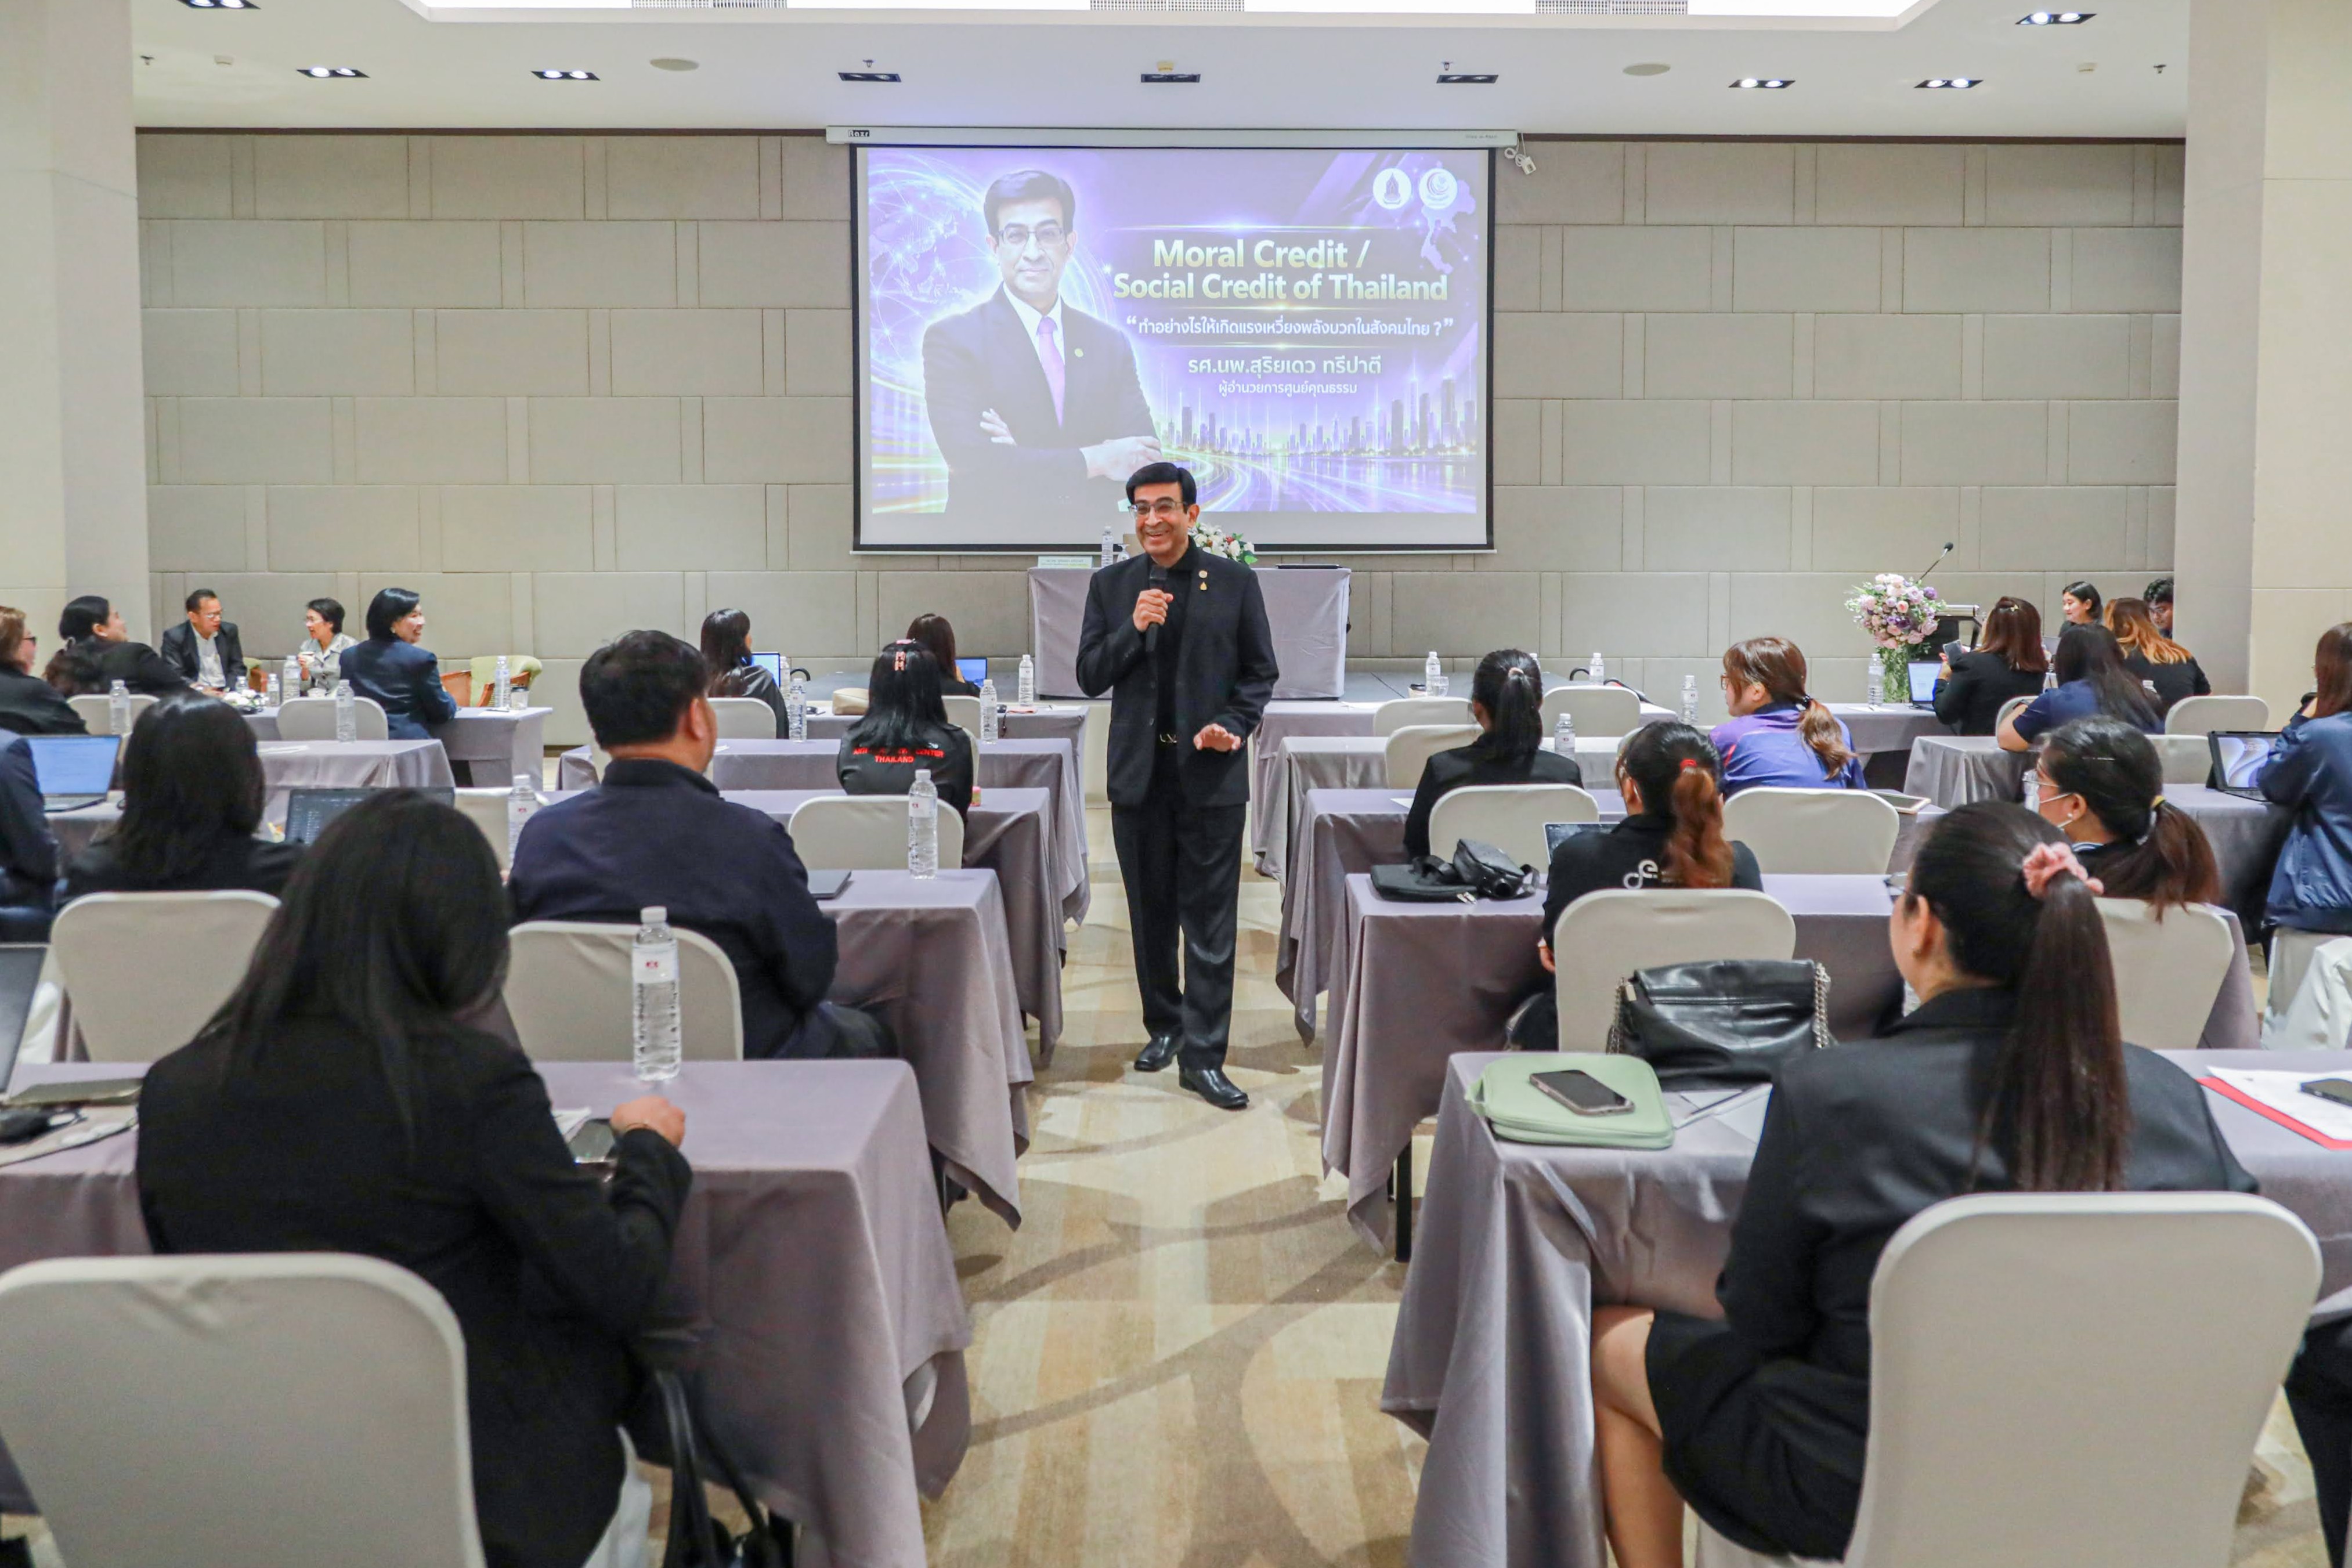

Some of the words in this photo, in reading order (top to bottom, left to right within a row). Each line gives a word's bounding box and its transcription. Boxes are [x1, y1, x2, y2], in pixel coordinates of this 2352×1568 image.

[1154, 239, 1244, 268] Moral
[1253, 239, 1348, 268] Credit
[1356, 239, 1371, 269] /
[1113, 272, 1194, 299] Social
[1202, 273, 1287, 299] Credit
[1293, 272, 1323, 300] of
[1329, 273, 1448, 301] Thailand
[1323, 355, 1382, 374] ทรีปาตี
[1219, 380, 1357, 398] ผู้อำนวยการศูนย์คุณธรรม
[874, 755, 915, 763] THAILAND
